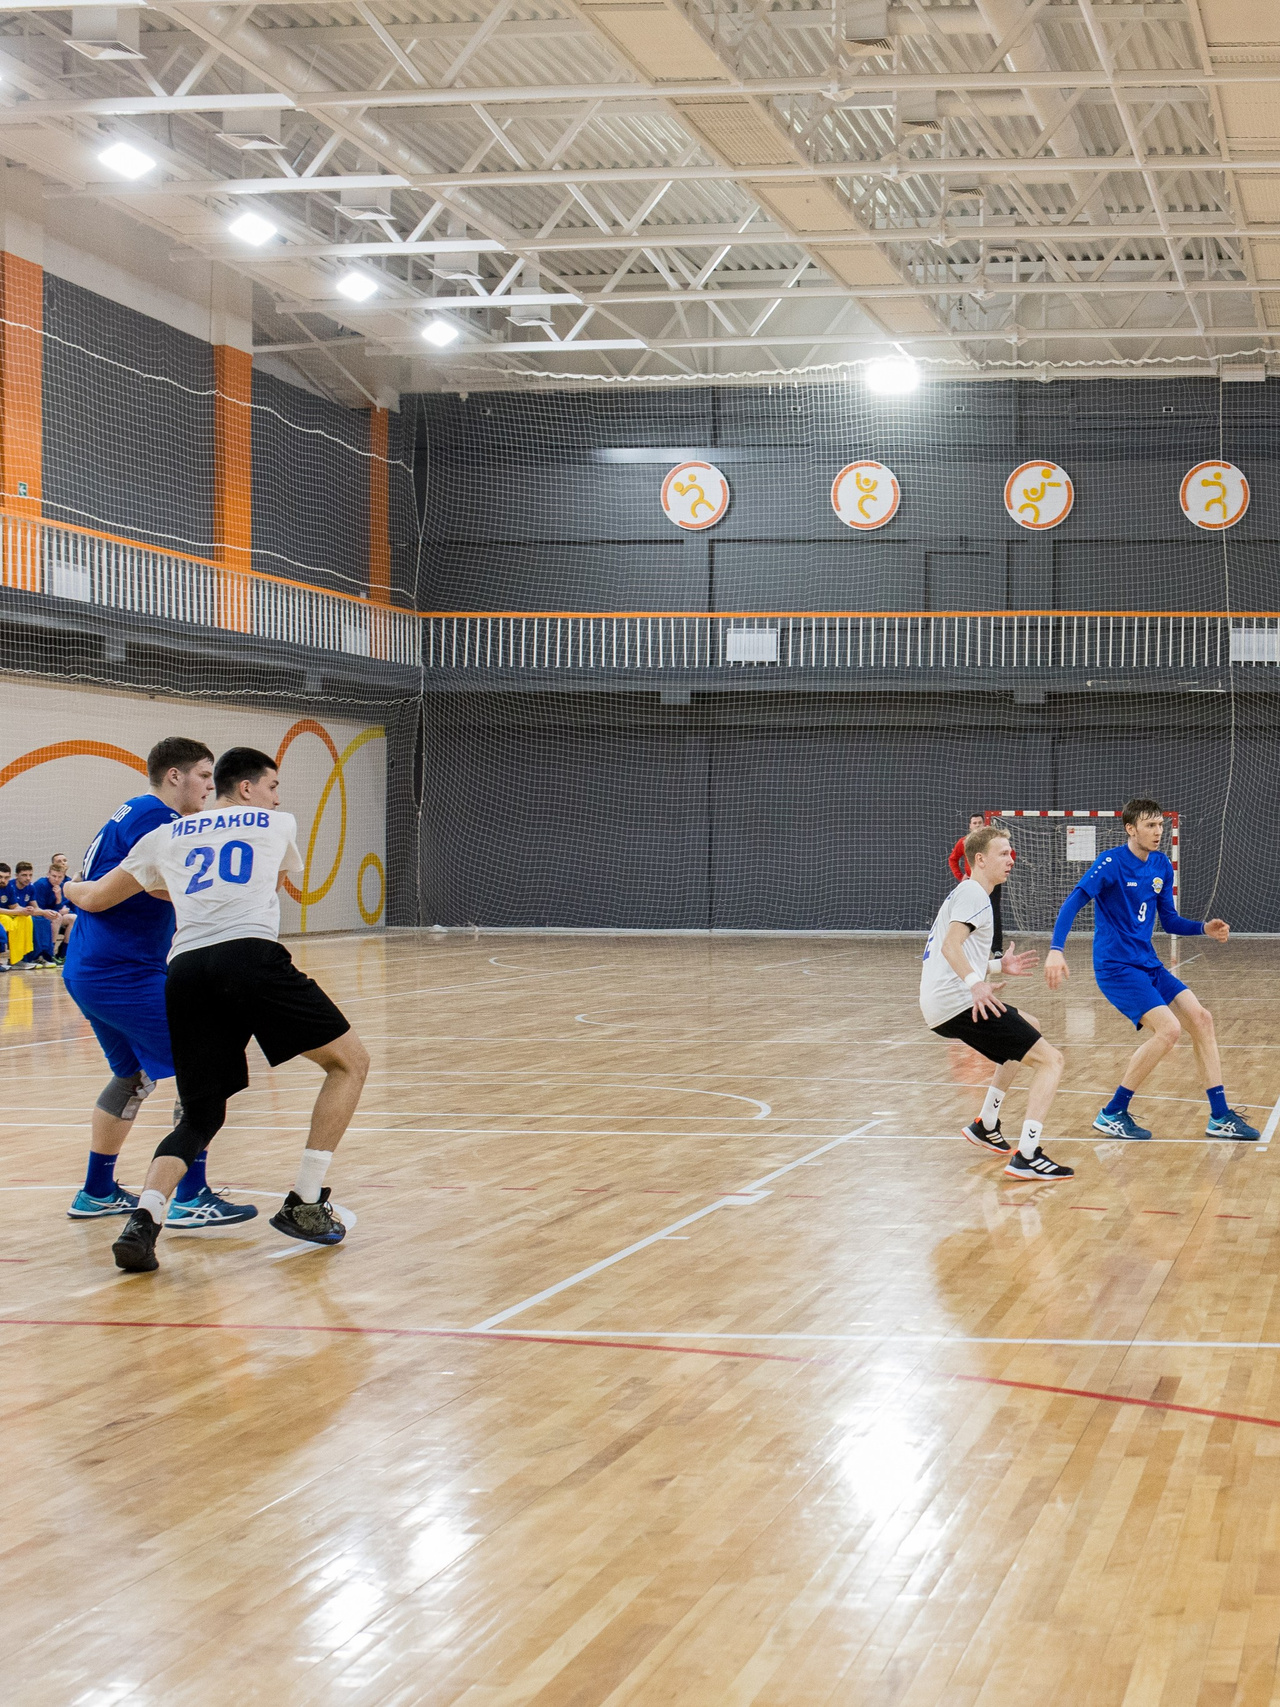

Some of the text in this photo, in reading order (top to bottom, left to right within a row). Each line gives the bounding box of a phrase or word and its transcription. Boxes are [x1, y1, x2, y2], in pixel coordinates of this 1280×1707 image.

[171, 811, 270, 839] ИБРАКОВ
[185, 840, 254, 895] 20
[1138, 902, 1147, 922] 9
